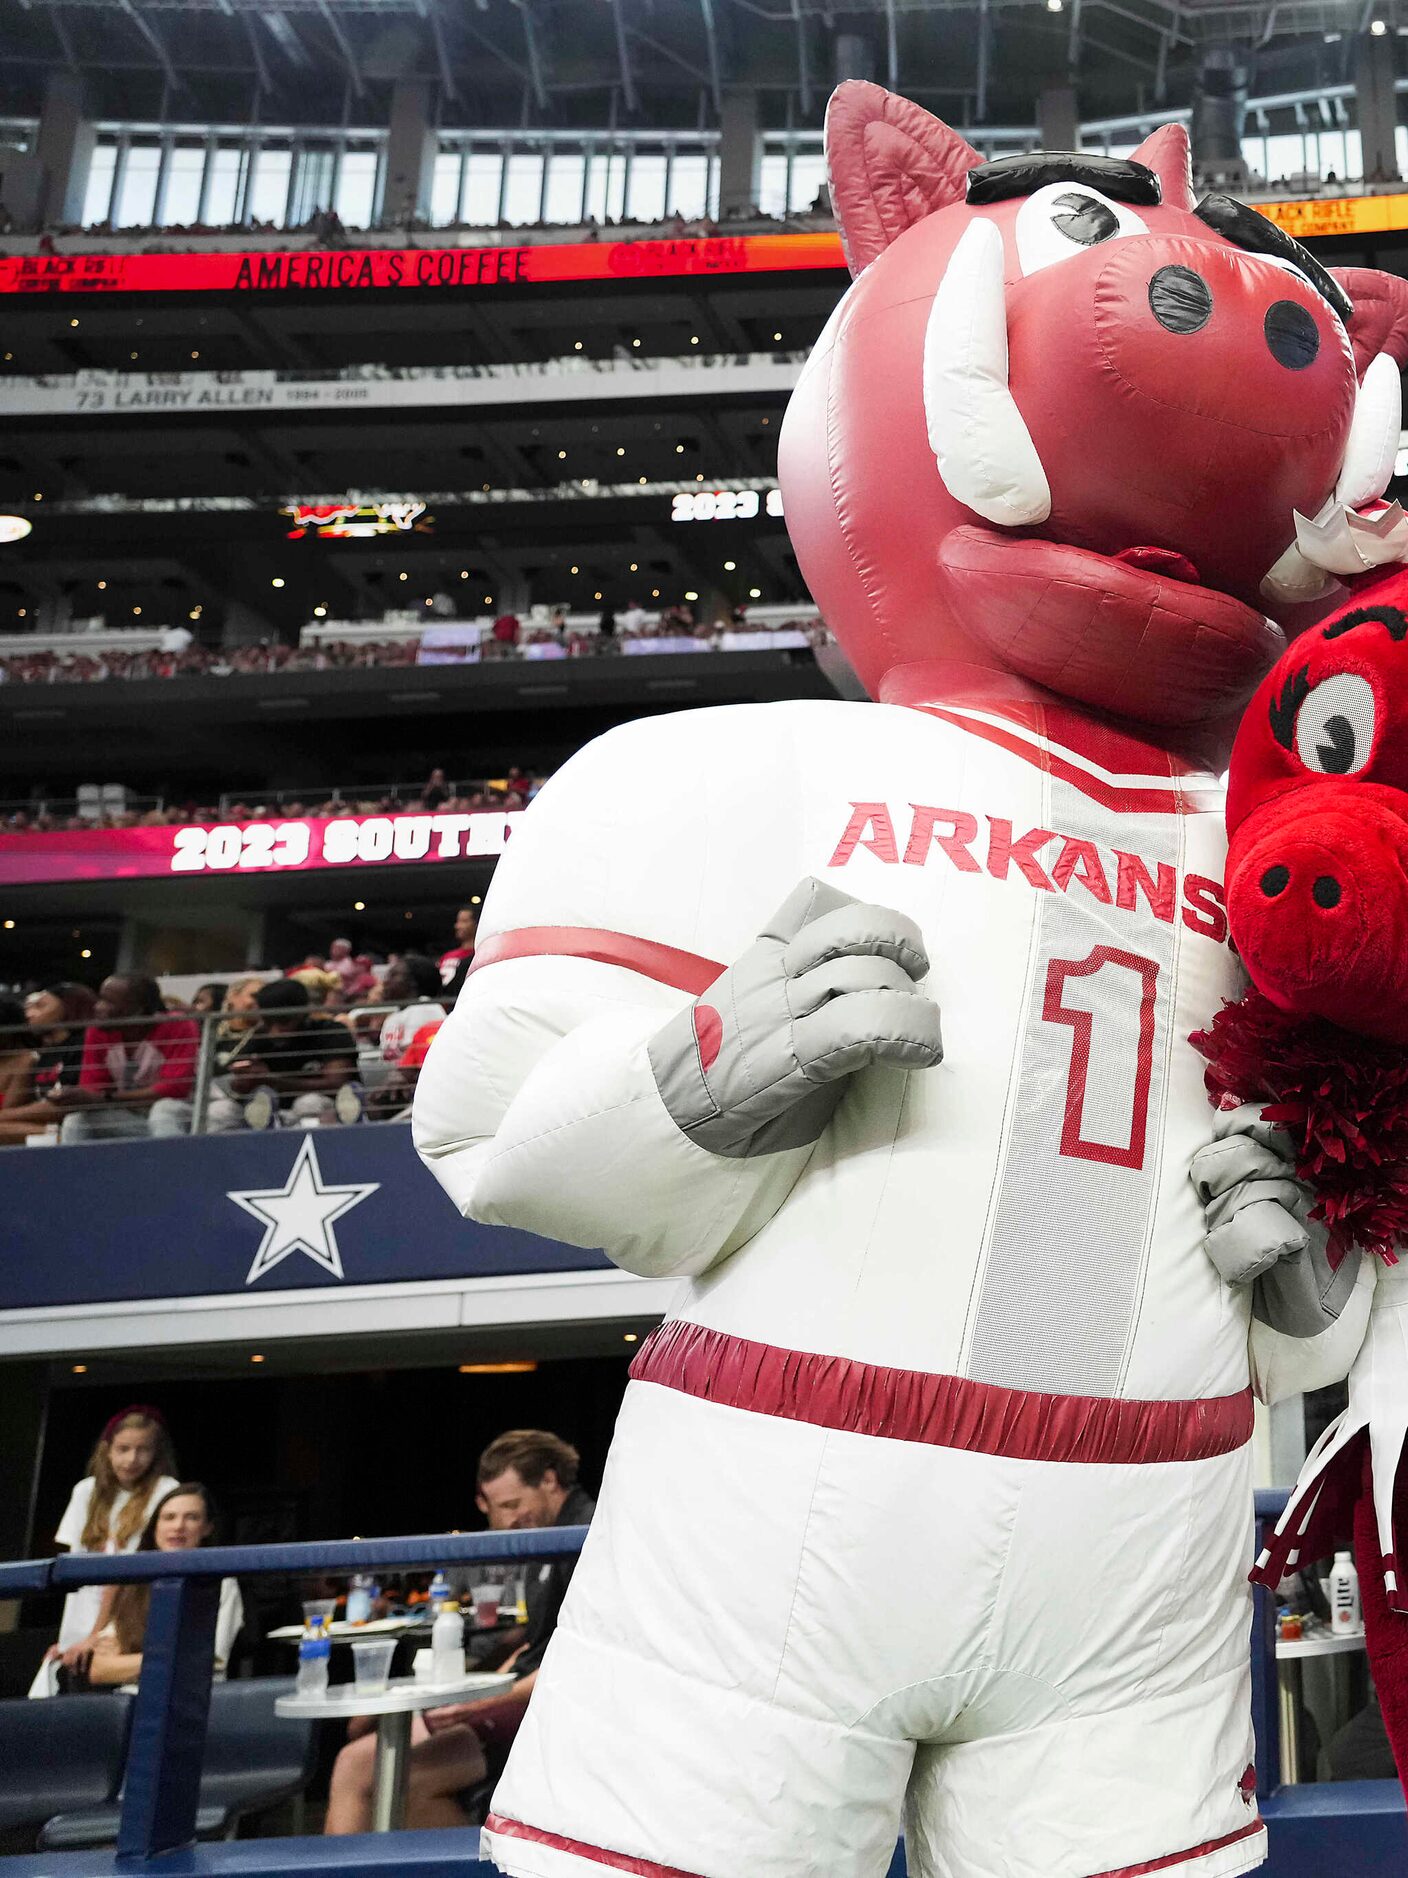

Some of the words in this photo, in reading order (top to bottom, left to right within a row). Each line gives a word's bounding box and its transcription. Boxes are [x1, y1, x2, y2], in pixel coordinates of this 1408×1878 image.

[234, 255, 404, 290] AMERICA'S
[417, 250, 530, 285] COFFEE
[76, 392, 104, 410] 73
[114, 390, 192, 408] LARRY
[199, 387, 274, 405] ALLEN
[671, 490, 760, 522] 2023
[170, 821, 311, 872] 2023
[322, 811, 526, 863] SOUTH
[827, 801, 1236, 954] ARKANS
[1042, 944, 1160, 1171] 1
